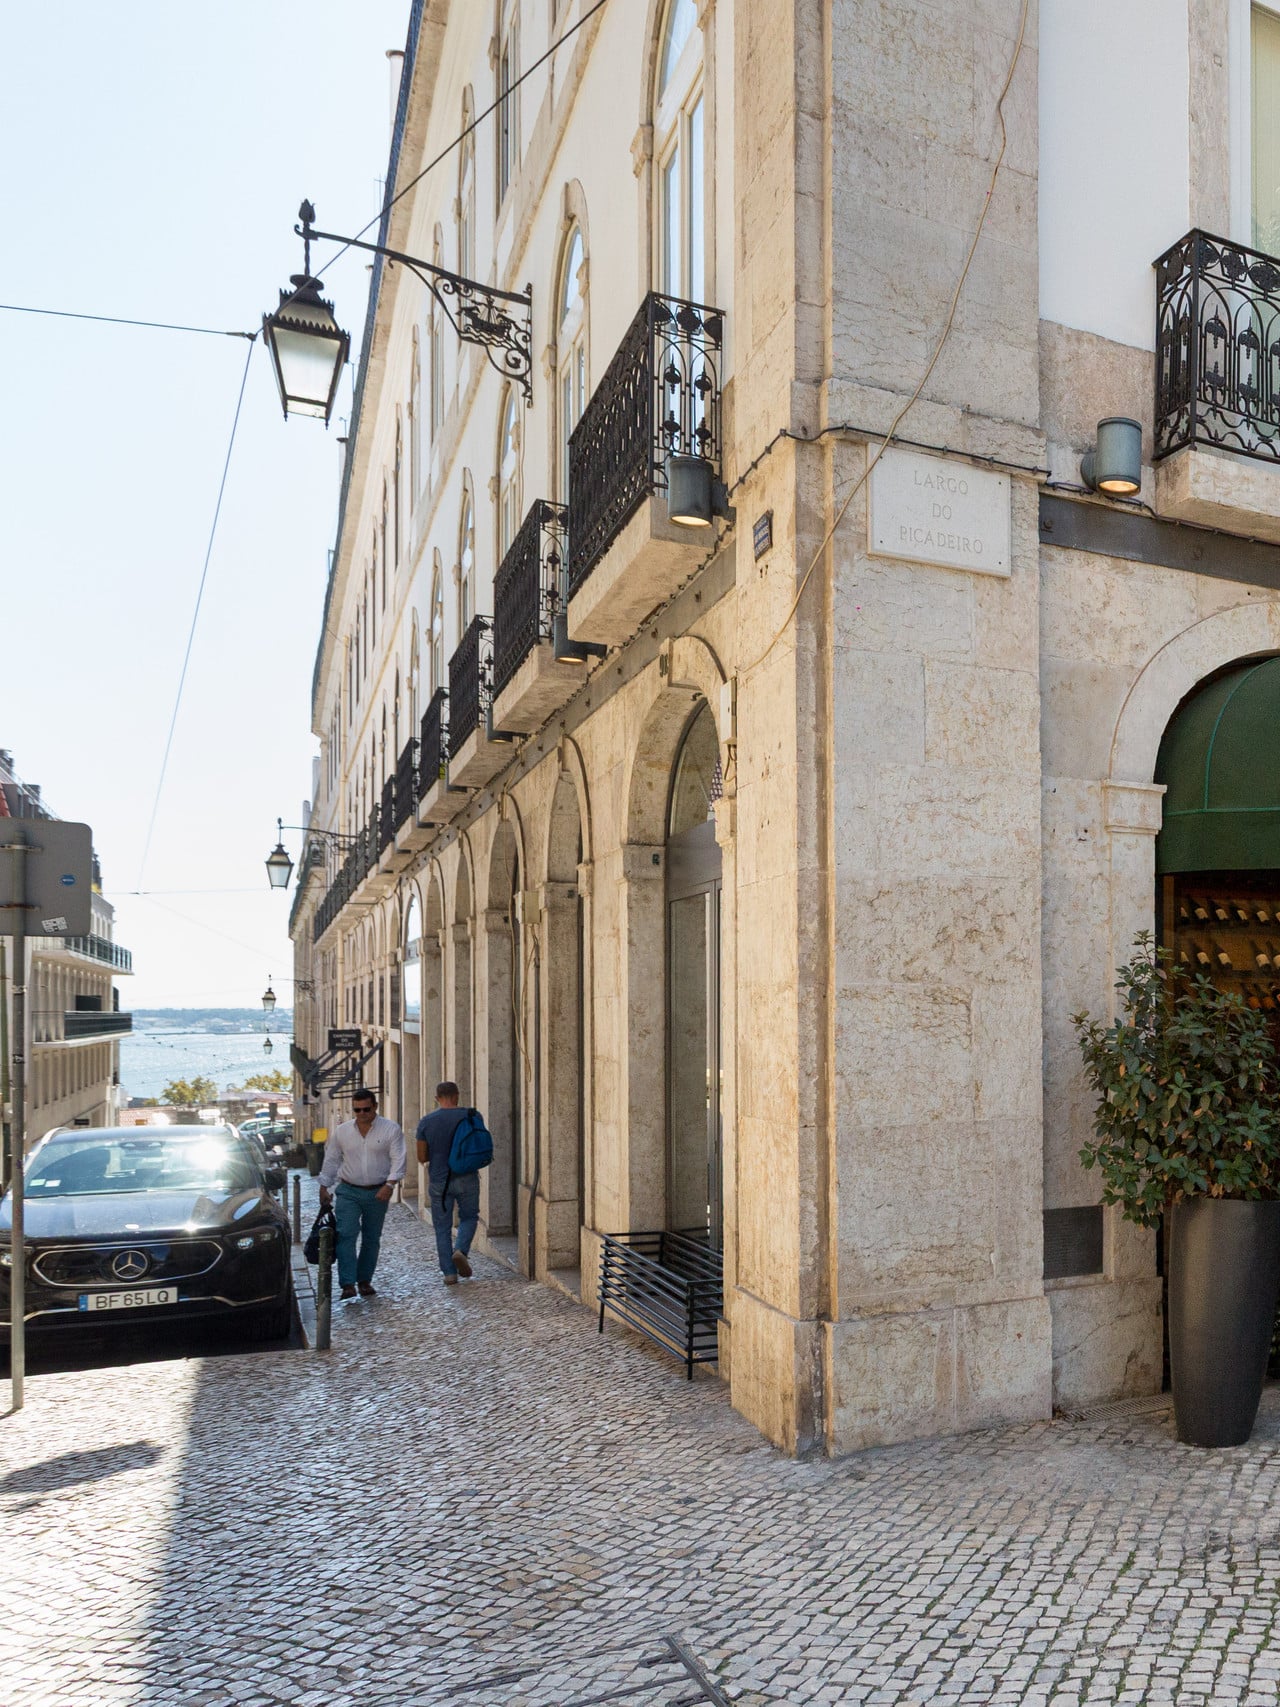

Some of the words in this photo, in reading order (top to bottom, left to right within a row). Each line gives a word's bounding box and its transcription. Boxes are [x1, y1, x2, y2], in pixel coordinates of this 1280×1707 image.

[913, 470, 969, 495] LARGO
[932, 503, 952, 520] DO
[900, 525, 983, 554] PICADEIRO
